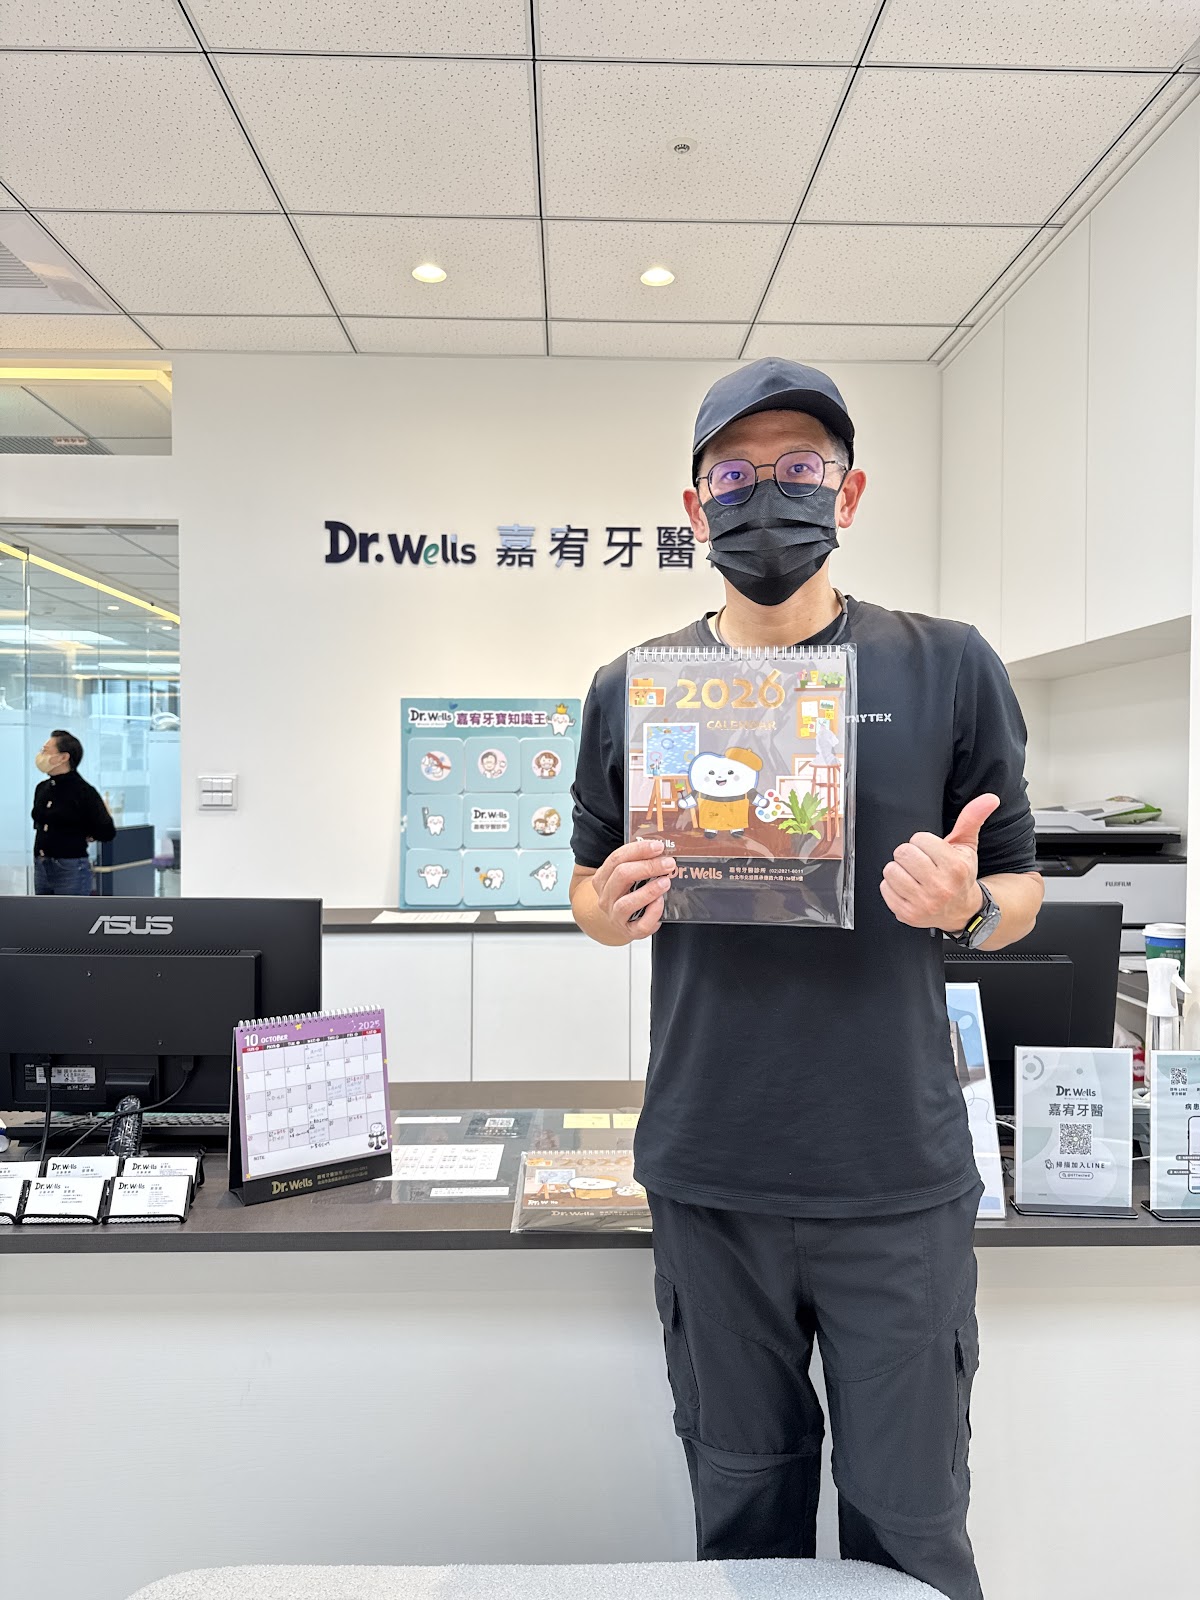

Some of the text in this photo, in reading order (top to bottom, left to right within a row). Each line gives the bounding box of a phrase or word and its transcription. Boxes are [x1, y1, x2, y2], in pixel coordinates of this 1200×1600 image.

[325, 520, 477, 565] Dr. Wells
[496, 523, 714, 569] 嘉宥牙醫
[675, 668, 786, 710] 2026
[706, 720, 777, 731] CALENDAR
[689, 867, 723, 879] Wells
[88, 915, 174, 935] ASUS
[358, 1020, 380, 1030] 2025
[244, 1034, 288, 1047] 10 OCTOBER
[1056, 1085, 1096, 1097] Dr. Wells
[1048, 1103, 1104, 1118] 嘉宥牙醫
[271, 1180, 288, 1195] Dr.
[288, 1178, 313, 1189] Wells
